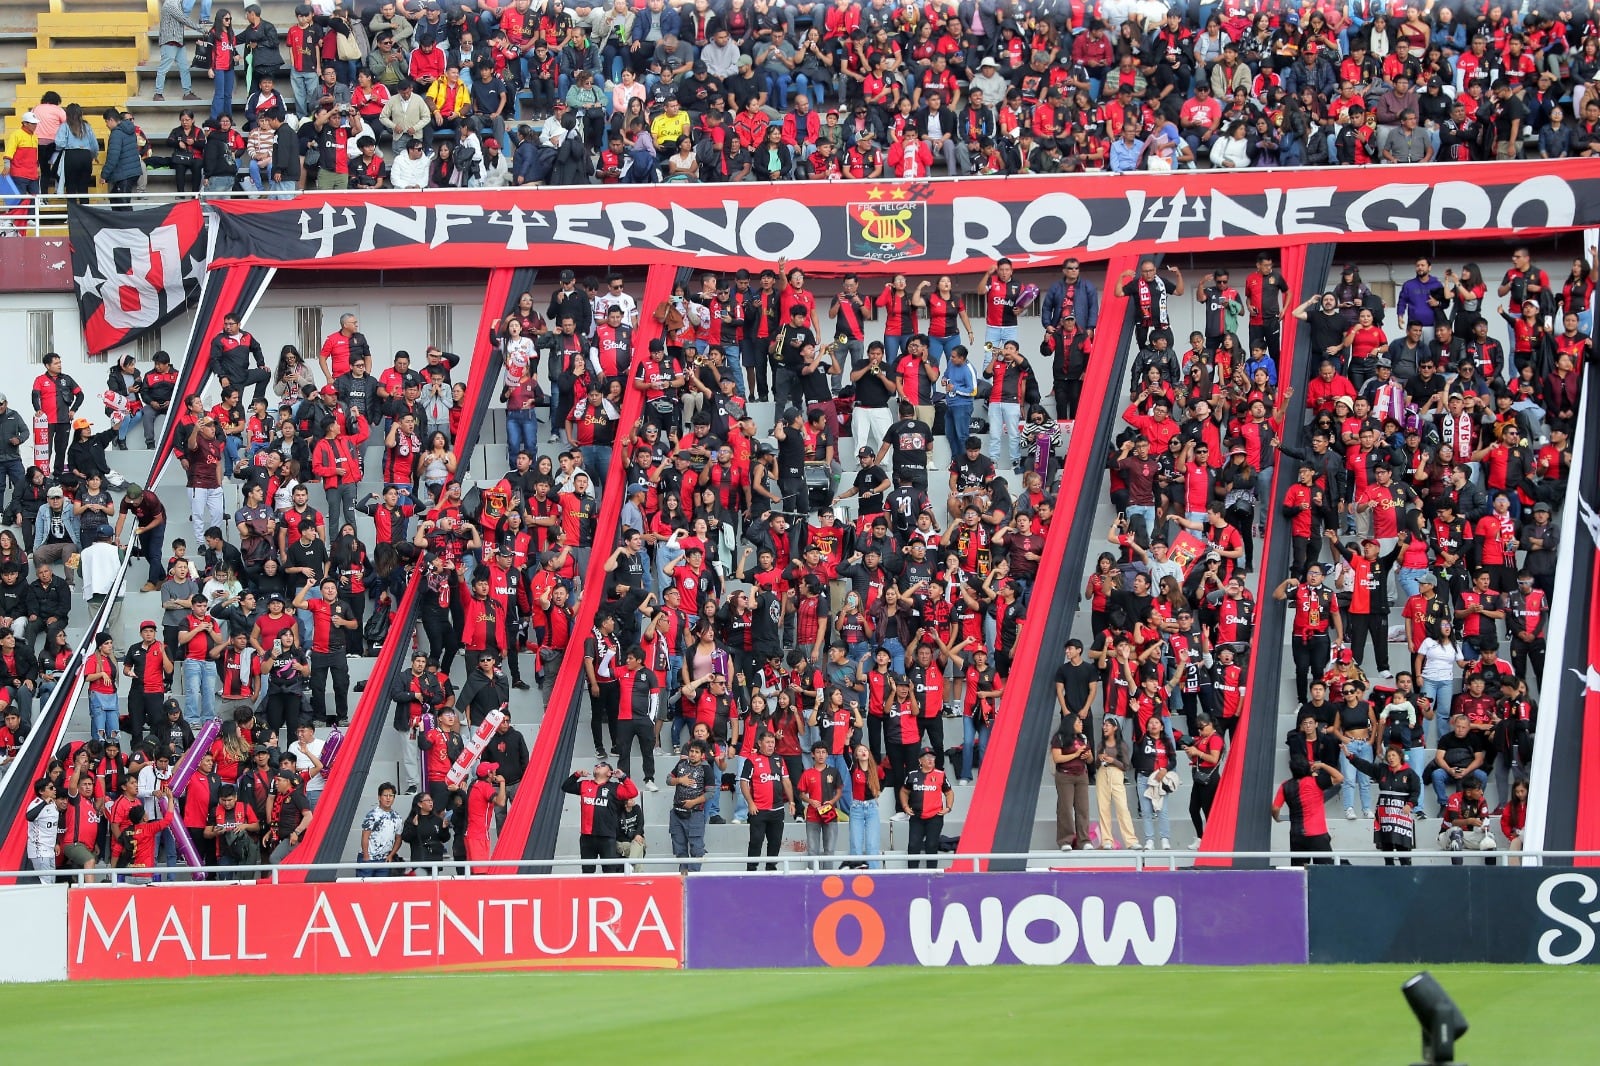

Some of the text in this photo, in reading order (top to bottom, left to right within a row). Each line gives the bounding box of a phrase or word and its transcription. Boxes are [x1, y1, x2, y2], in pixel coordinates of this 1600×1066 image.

[94, 224, 186, 330] 81
[601, 339, 627, 351] Stake
[649, 372, 671, 383] Stake
[583, 415, 606, 426] Stake
[1380, 498, 1403, 510] Stake
[1439, 538, 1458, 548] Stake
[1225, 615, 1248, 626] Stake
[1414, 611, 1436, 625] Stake
[912, 784, 935, 792] Betano
[583, 797, 607, 806] VOLCAN
[1537, 873, 1600, 965] S
[75, 890, 675, 965] MALL AVENTURA
[909, 894, 1177, 967] WOW
